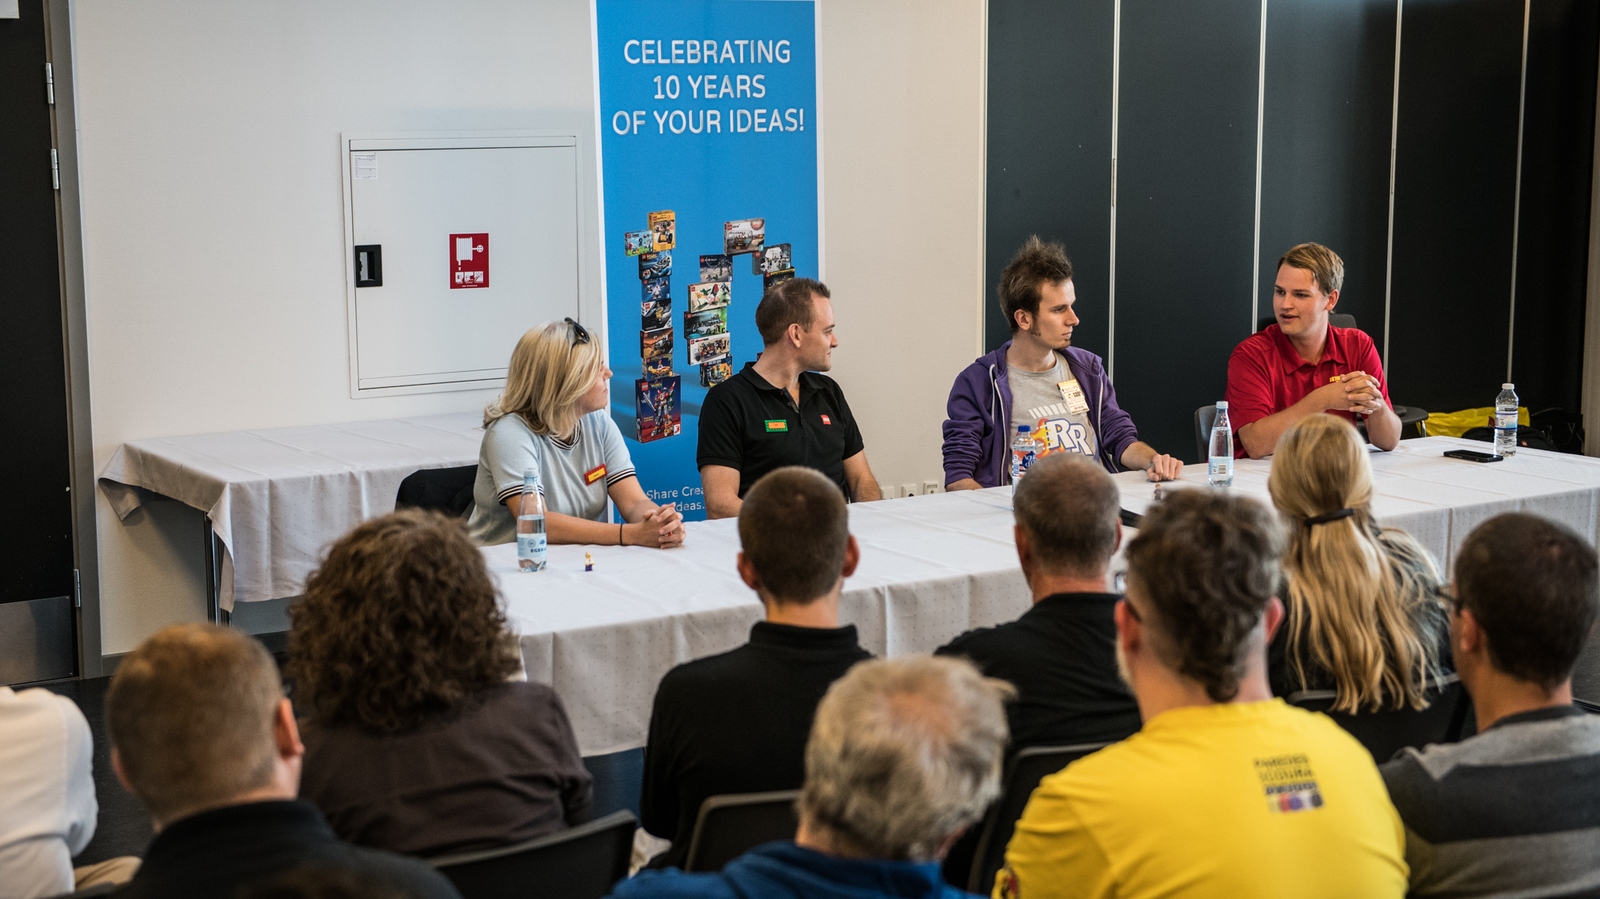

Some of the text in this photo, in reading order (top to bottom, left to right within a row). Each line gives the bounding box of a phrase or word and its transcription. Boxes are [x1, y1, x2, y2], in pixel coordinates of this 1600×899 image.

[623, 39, 791, 64] CELEBRATING
[653, 74, 766, 99] 10 YEARS
[612, 108, 804, 135] OF YOUR IDEAS!
[646, 489, 679, 500] Share
